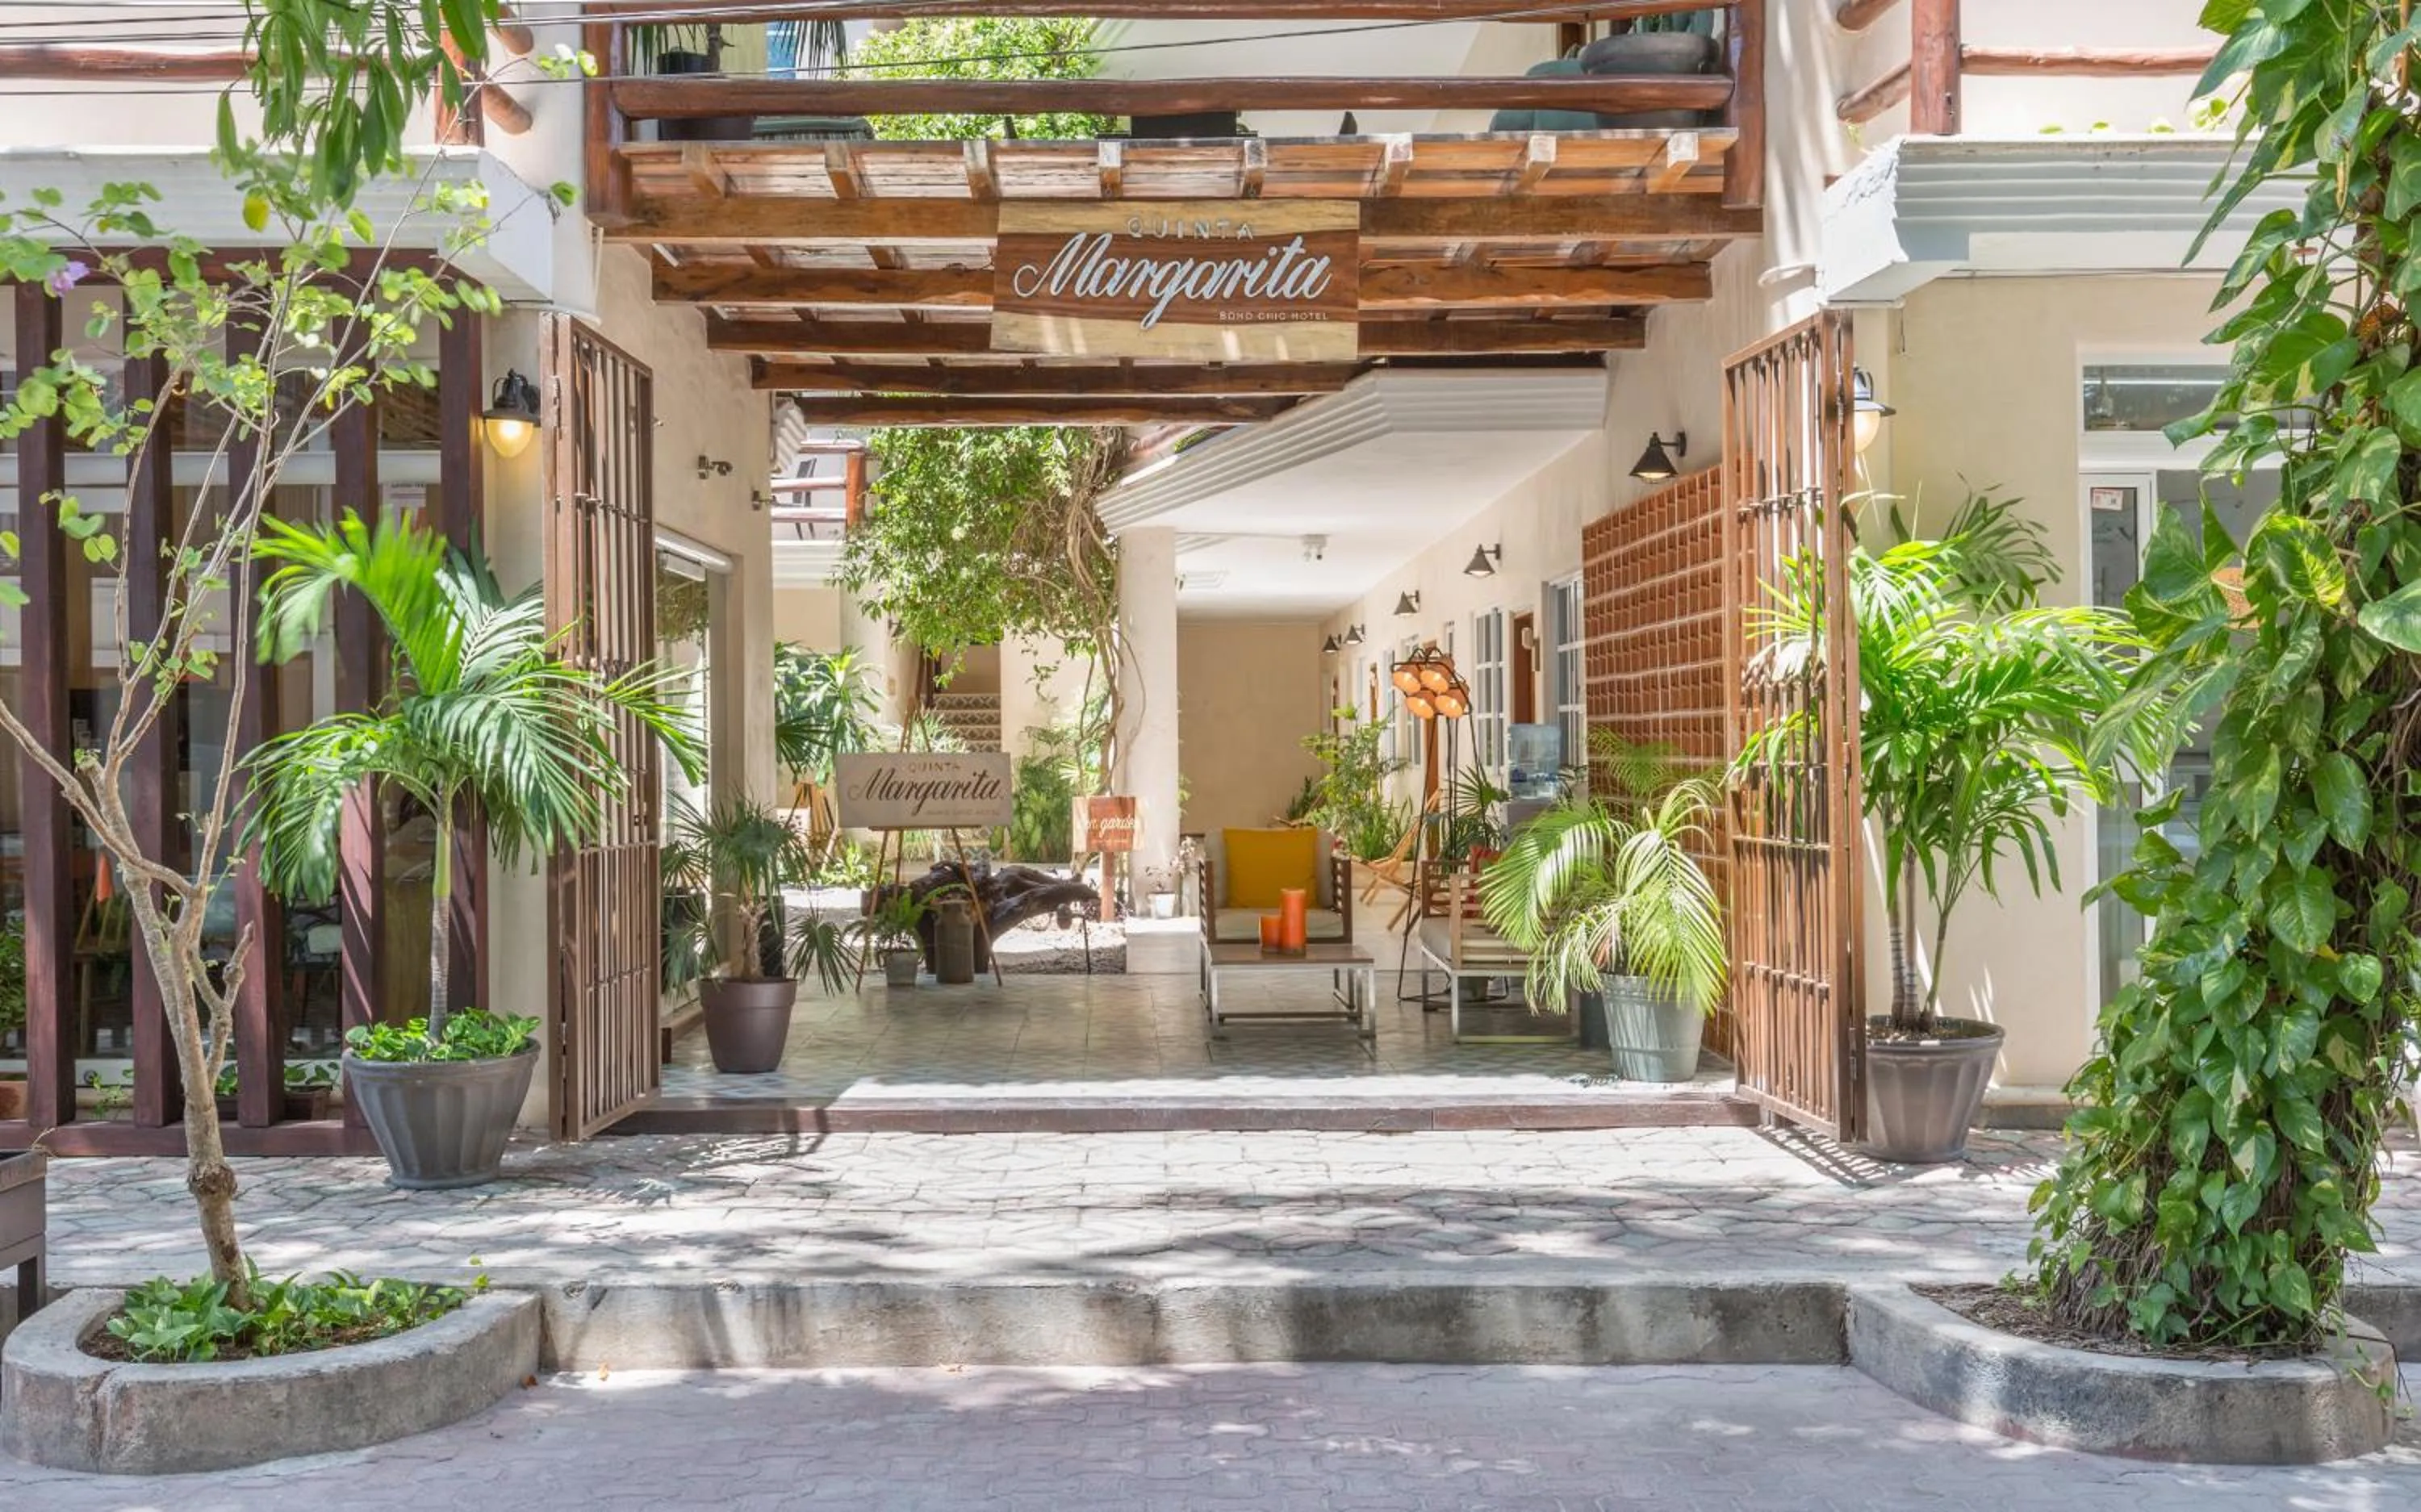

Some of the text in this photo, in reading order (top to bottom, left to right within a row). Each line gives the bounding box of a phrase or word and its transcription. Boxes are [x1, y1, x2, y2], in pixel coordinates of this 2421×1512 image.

[1127, 216, 1253, 240] QUINTA
[1013, 232, 1333, 331] Margarita
[1219, 311, 1330, 320] BOHO CHIC HOTEL
[908, 762, 961, 773] QUINTA
[847, 767, 1005, 817] Margarita
[1098, 813, 1140, 839] garde
